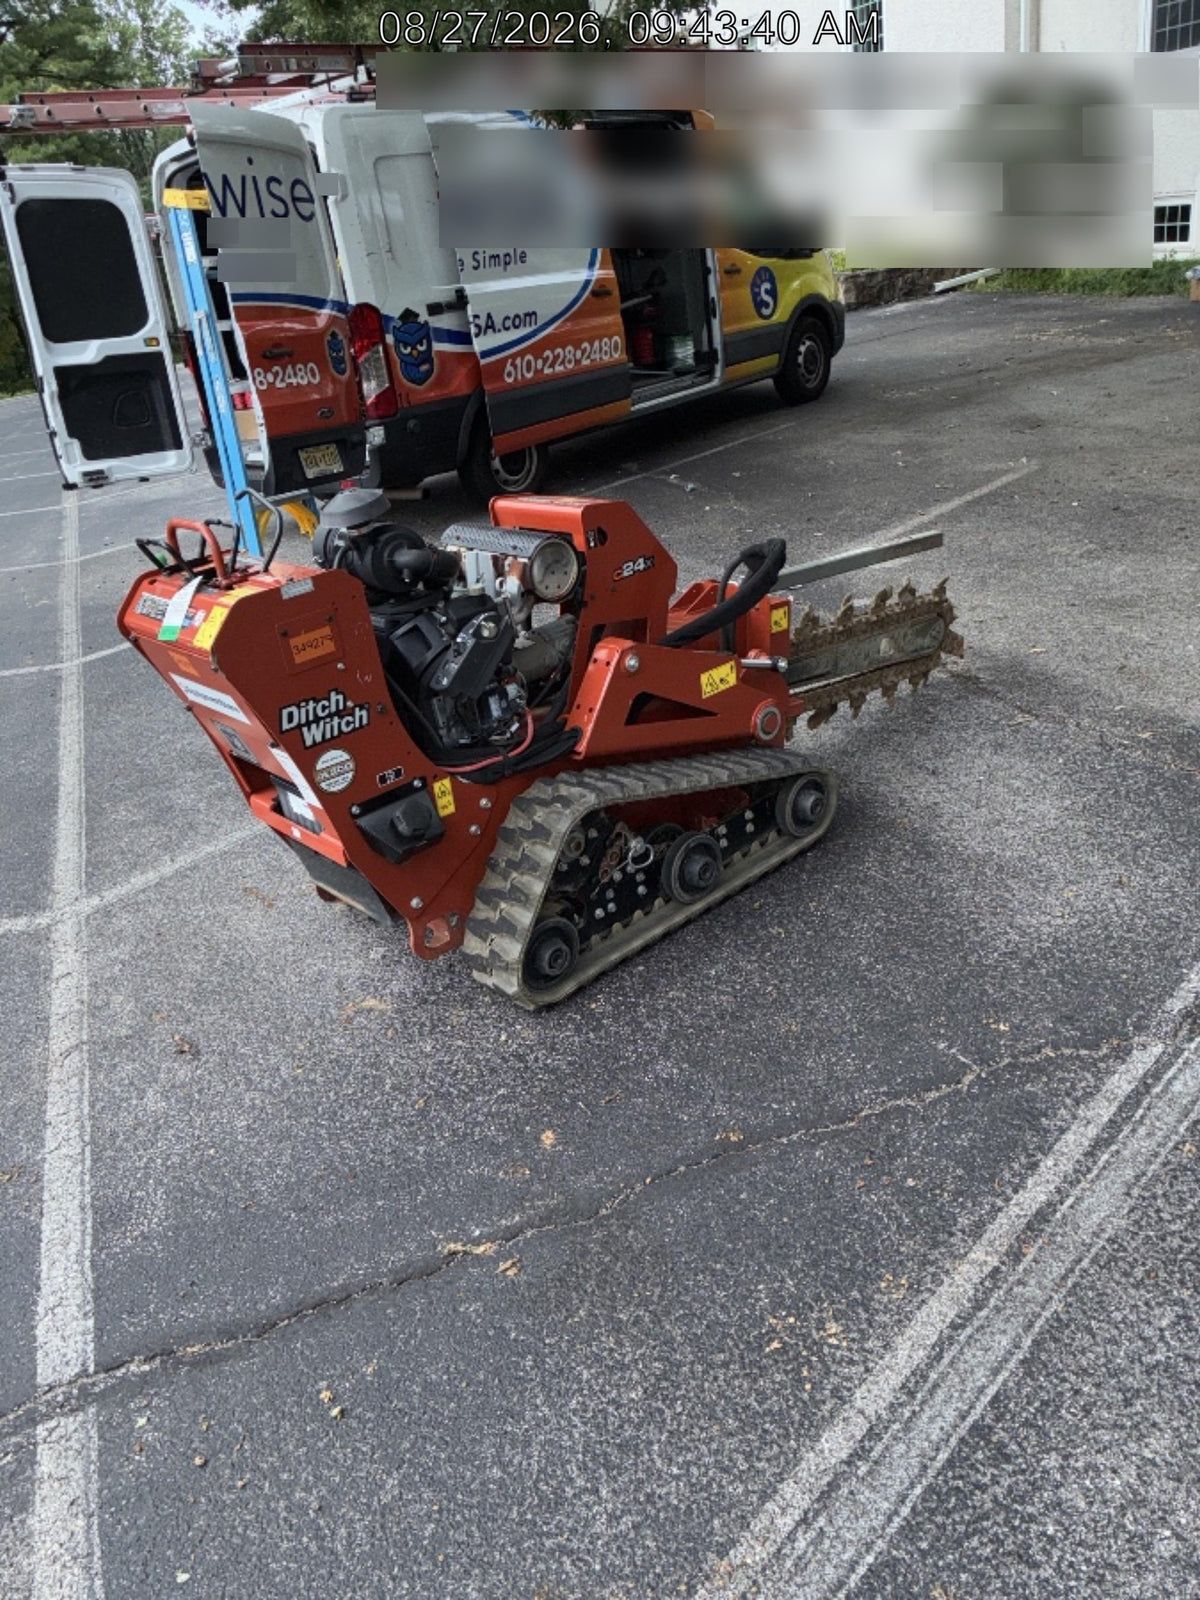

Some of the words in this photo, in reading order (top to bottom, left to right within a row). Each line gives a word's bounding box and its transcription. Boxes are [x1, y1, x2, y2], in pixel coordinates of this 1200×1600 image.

[472, 247, 527, 272] Simple
[281, 690, 345, 732] Ditch
[301, 706, 369, 748] Witch
